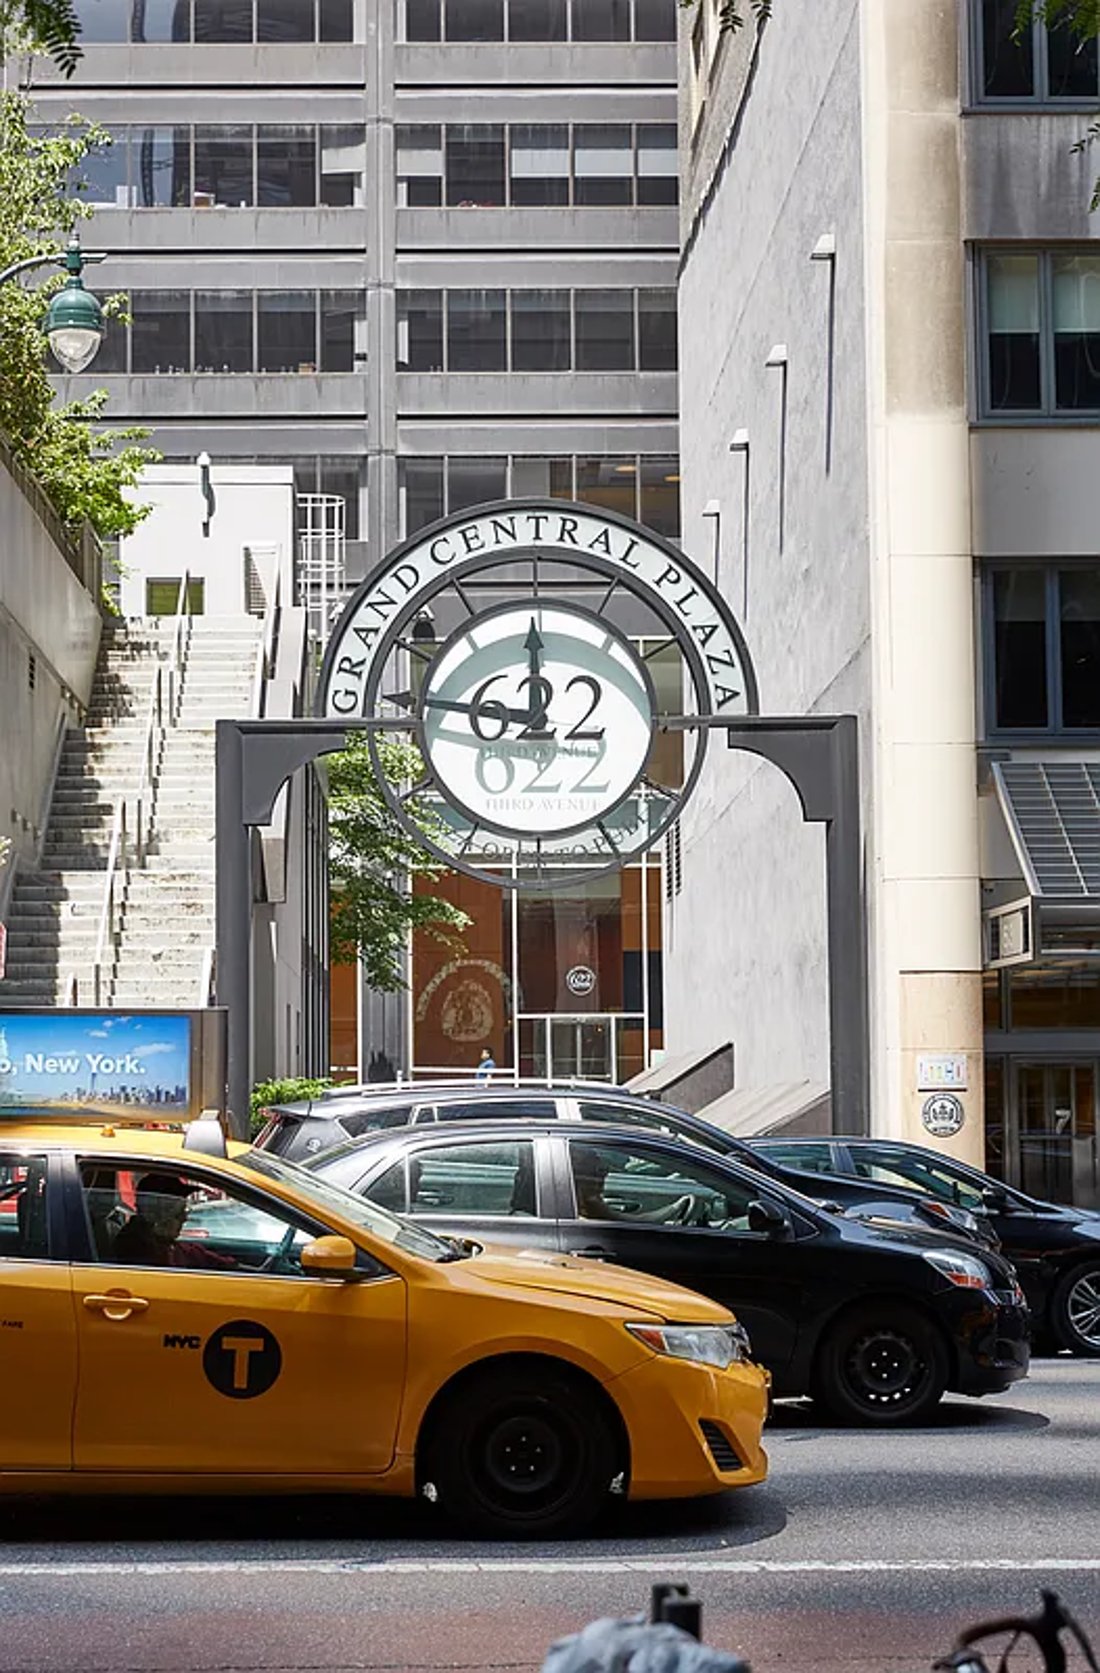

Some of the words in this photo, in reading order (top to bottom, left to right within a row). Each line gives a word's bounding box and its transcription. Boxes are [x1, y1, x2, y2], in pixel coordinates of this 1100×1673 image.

[332, 564, 420, 713] GRAND
[429, 515, 641, 569] CENTRAL
[653, 564, 741, 710] PLAZA
[469, 674, 606, 742] 622
[25, 1054, 80, 1073] New
[86, 1054, 146, 1074] York.
[163, 1334, 202, 1350] NYC
[221, 1336, 265, 1389] T
